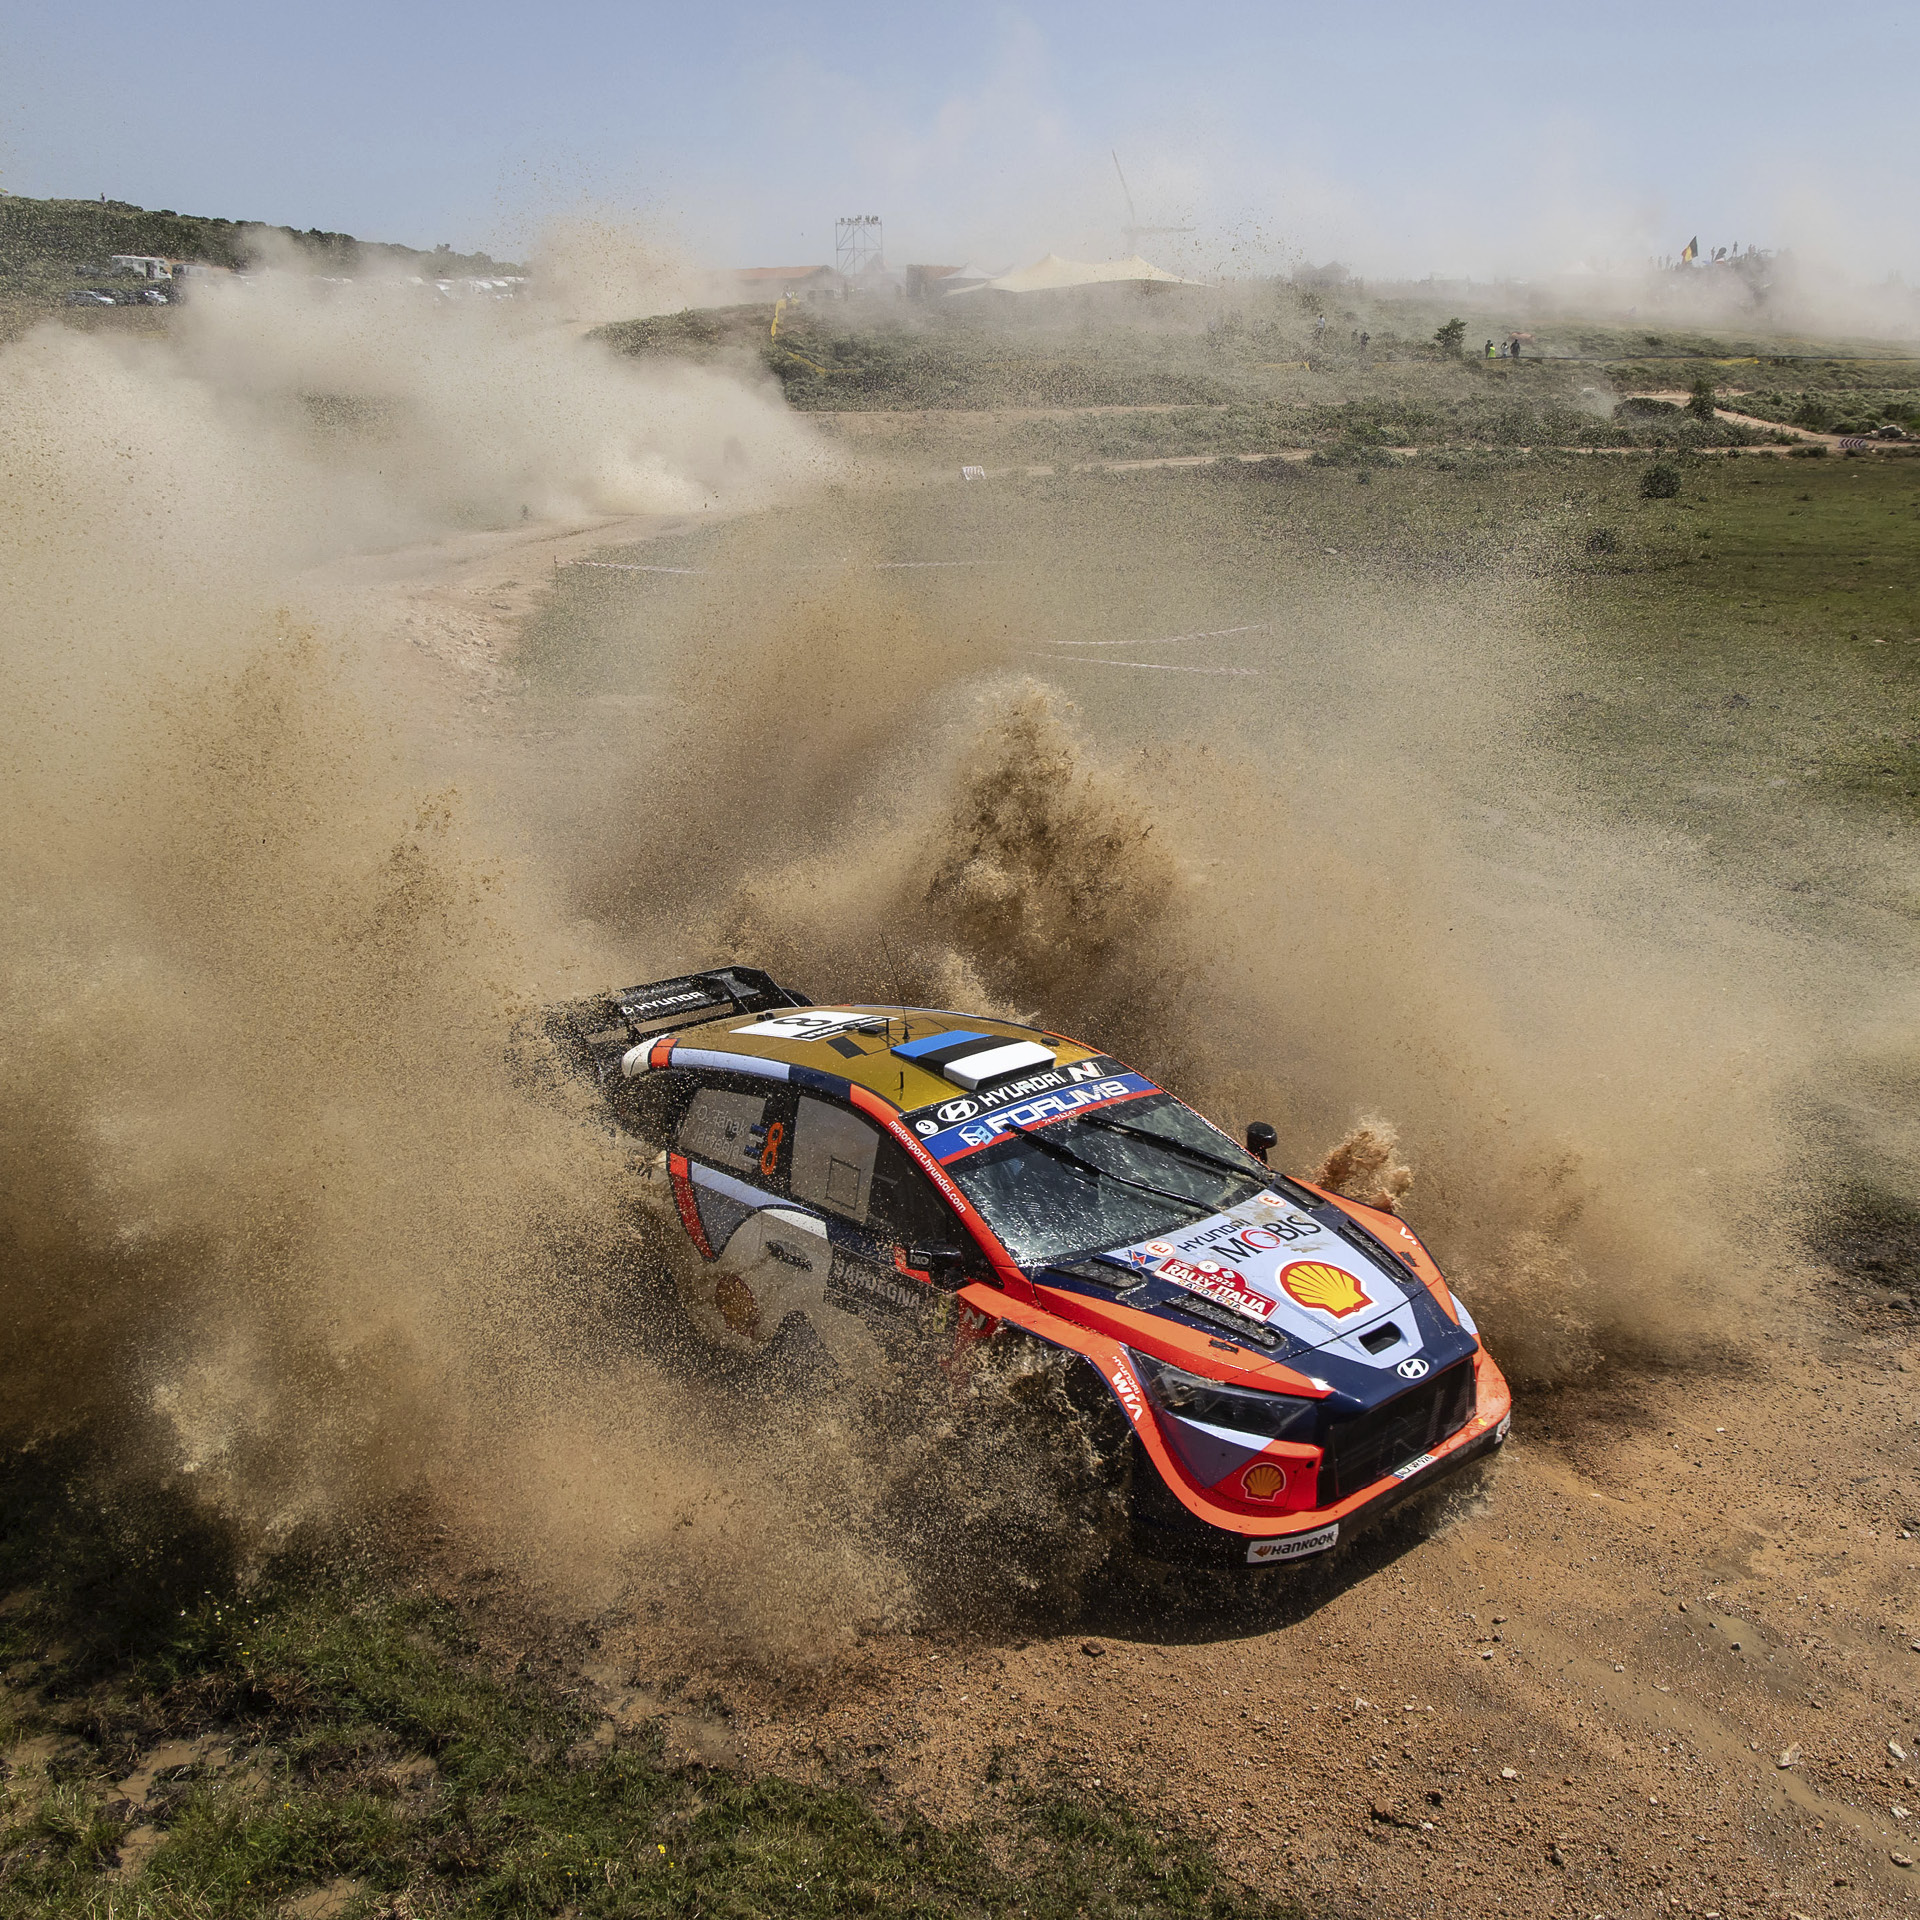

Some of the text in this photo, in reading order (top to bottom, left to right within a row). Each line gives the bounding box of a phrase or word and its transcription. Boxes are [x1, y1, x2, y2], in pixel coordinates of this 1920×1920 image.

[978, 1072, 1066, 1107] HYUNDAI
[984, 1080, 1130, 1134] FORUM8
[761, 1122, 784, 1175] 8
[919, 1121, 931, 1130] 3
[888, 1120, 967, 1214] motorsport.hyundai.com
[1177, 1219, 1253, 1252] HYUNDAI
[1209, 1216, 1322, 1264] MOBIS
[833, 1261, 921, 1309] SARDEGNA
[1165, 1265, 1216, 1287] RALLY
[1215, 1286, 1267, 1314] ITALIA
[1209, 1274, 1236, 1288] 2025
[1112, 1355, 1140, 1394] HYUNDAI
